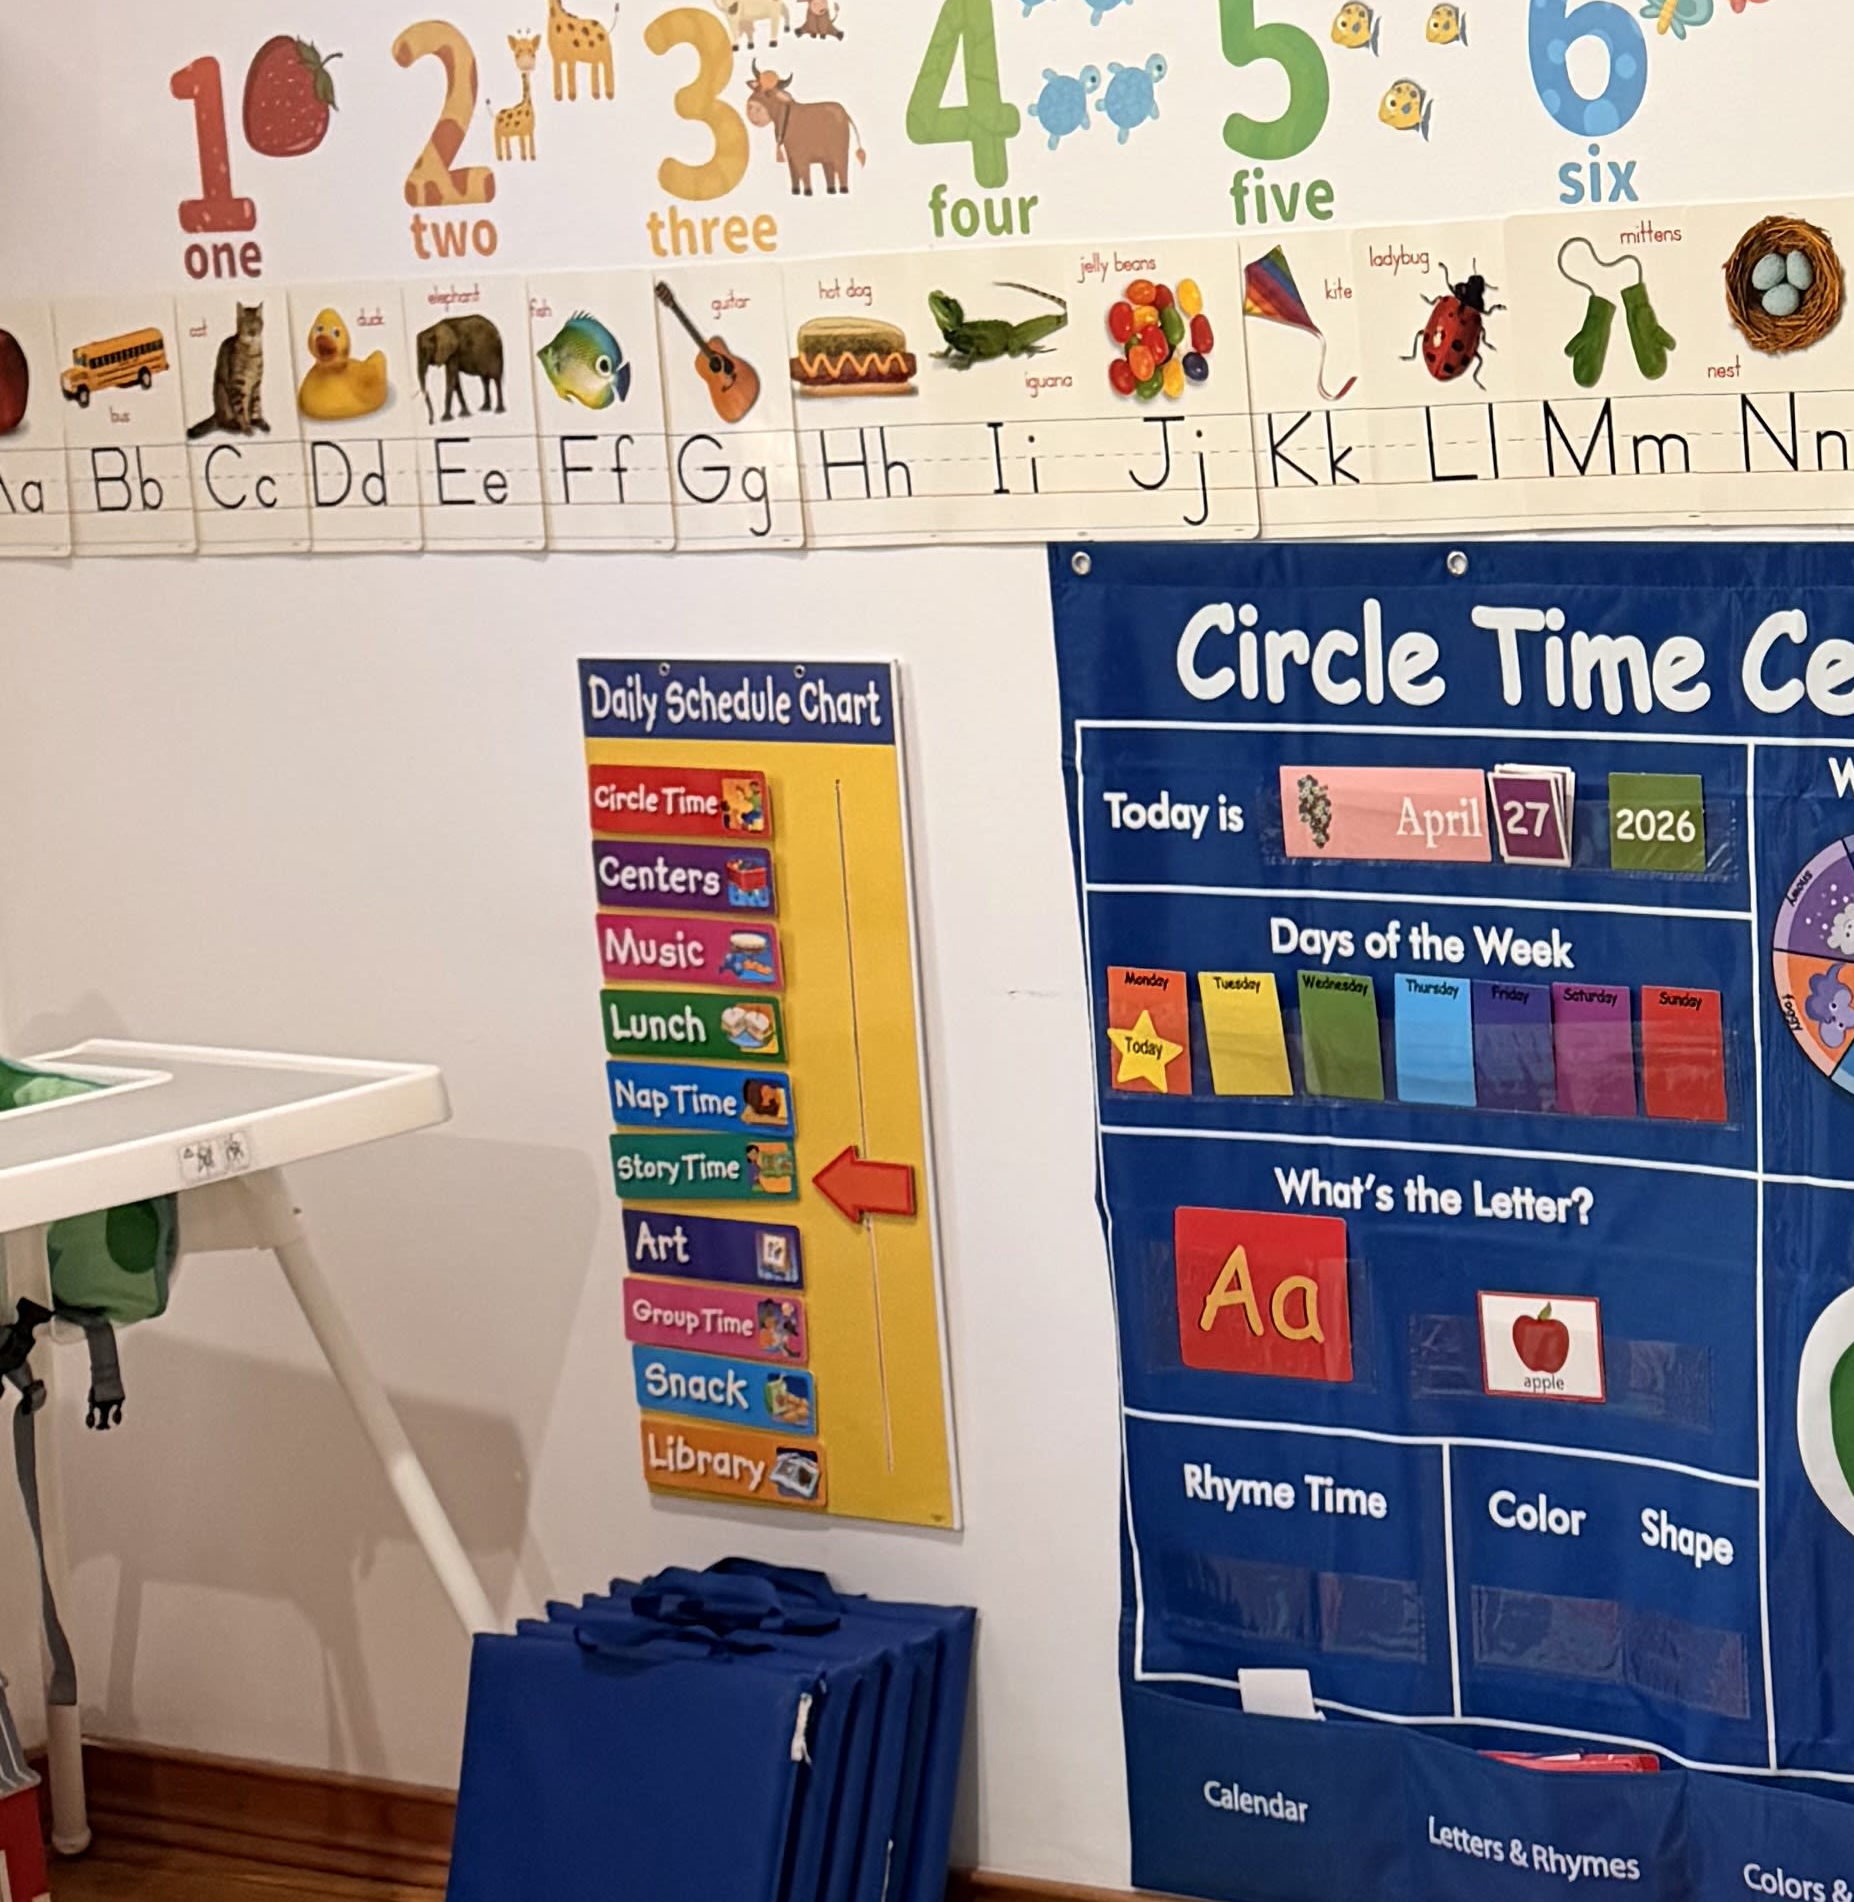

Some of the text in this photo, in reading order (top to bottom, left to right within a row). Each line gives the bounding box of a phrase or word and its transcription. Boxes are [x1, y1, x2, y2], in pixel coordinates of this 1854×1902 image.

[390, 20, 496, 207] 2
[643, 6, 752, 202] 3
[169, 55, 257, 234] 1
[1230, 167, 1335, 225] five
[1557, 143, 1638, 205] six
[646, 204, 778, 257] three
[928, 184, 1039, 238] four
[409, 213, 499, 261] two
[1619, 225, 1682, 246] mittens
[183, 240, 264, 280] one
[1079, 254, 1157, 282] jelly beans
[1369, 247, 1429, 273] ladybug
[711, 291, 750, 320] guitar
[818, 278, 872, 304] hot dog
[1324, 279, 1352, 300] kite
[1024, 371, 1073, 392] iguana
[1707, 357, 1741, 379] nest
[1268, 409, 1359, 487] Kk
[1542, 398, 1689, 477] Mm
[1741, 392, 1848, 473] Nn
[91, 445, 164, 512] Bb
[310, 439, 388, 507] Dd
[558, 434, 634, 504] Ff
[819, 426, 912, 499] Hh
[1129, 416, 1209, 526] Jj
[1176, 598, 1446, 706] Circle
[1471, 605, 1712, 715] Time
[588, 673, 881, 732] Daily Schedule Chart
[594, 784, 718, 816] Circle Time
[1103, 791, 1245, 839] Today is
[1503, 799, 1549, 836] 27
[1396, 797, 1484, 851] April
[1615, 809, 1696, 842] 2026
[599, 856, 721, 896] Centers
[605, 928, 704, 969] Music
[1270, 917, 1574, 969] Days of the Week
[1124, 972, 1168, 991] Monday
[1213, 977, 1260, 993] Tuesday
[1302, 975, 1368, 996] Wednesday
[1406, 980, 1459, 999] Thursday
[1563, 988, 1618, 1007] Saturday
[1659, 991, 1702, 1011] Sunday
[610, 1004, 707, 1042] Lunch
[1125, 1036, 1163, 1060] Today
[615, 1080, 737, 1117] Nap Time
[617, 1153, 740, 1186] Story Time
[1274, 1168, 1594, 1225] What's the Letter?
[635, 1221, 690, 1264] Art
[1199, 1245, 1325, 1343] Aa
[632, 1299, 754, 1336] Group Time
[645, 1364, 748, 1409] Snack
[1523, 1375, 1565, 1394] apple
[648, 1434, 765, 1491] Library
[1183, 1463, 1389, 1519] Rhyme Time
[1488, 1490, 1587, 1537] Color
[1640, 1508, 1735, 1568] Shape
[1203, 1780, 1309, 1823] Calendar
[1428, 1816, 1641, 1883] Letters & Rhymes
